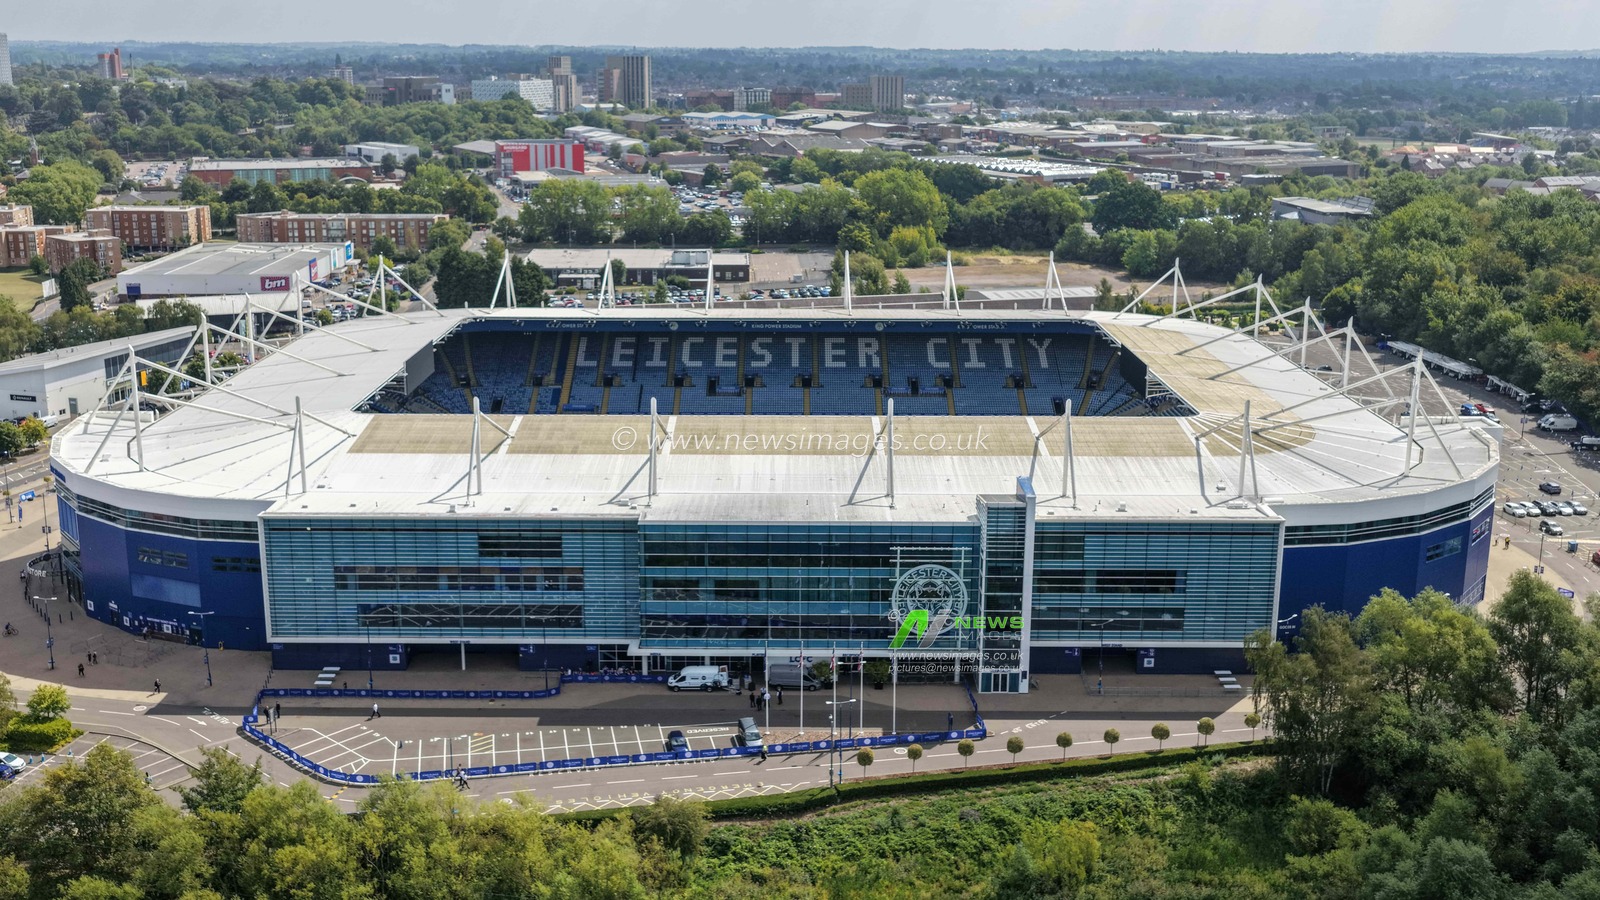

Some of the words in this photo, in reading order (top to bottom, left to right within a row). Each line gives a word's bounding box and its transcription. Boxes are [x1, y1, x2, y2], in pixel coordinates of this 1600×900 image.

[576, 336, 881, 368] LEICESTER
[926, 338, 1052, 368] CITY
[898, 568, 948, 598] LEICESTER
[686, 726, 730, 734] RESERVED
